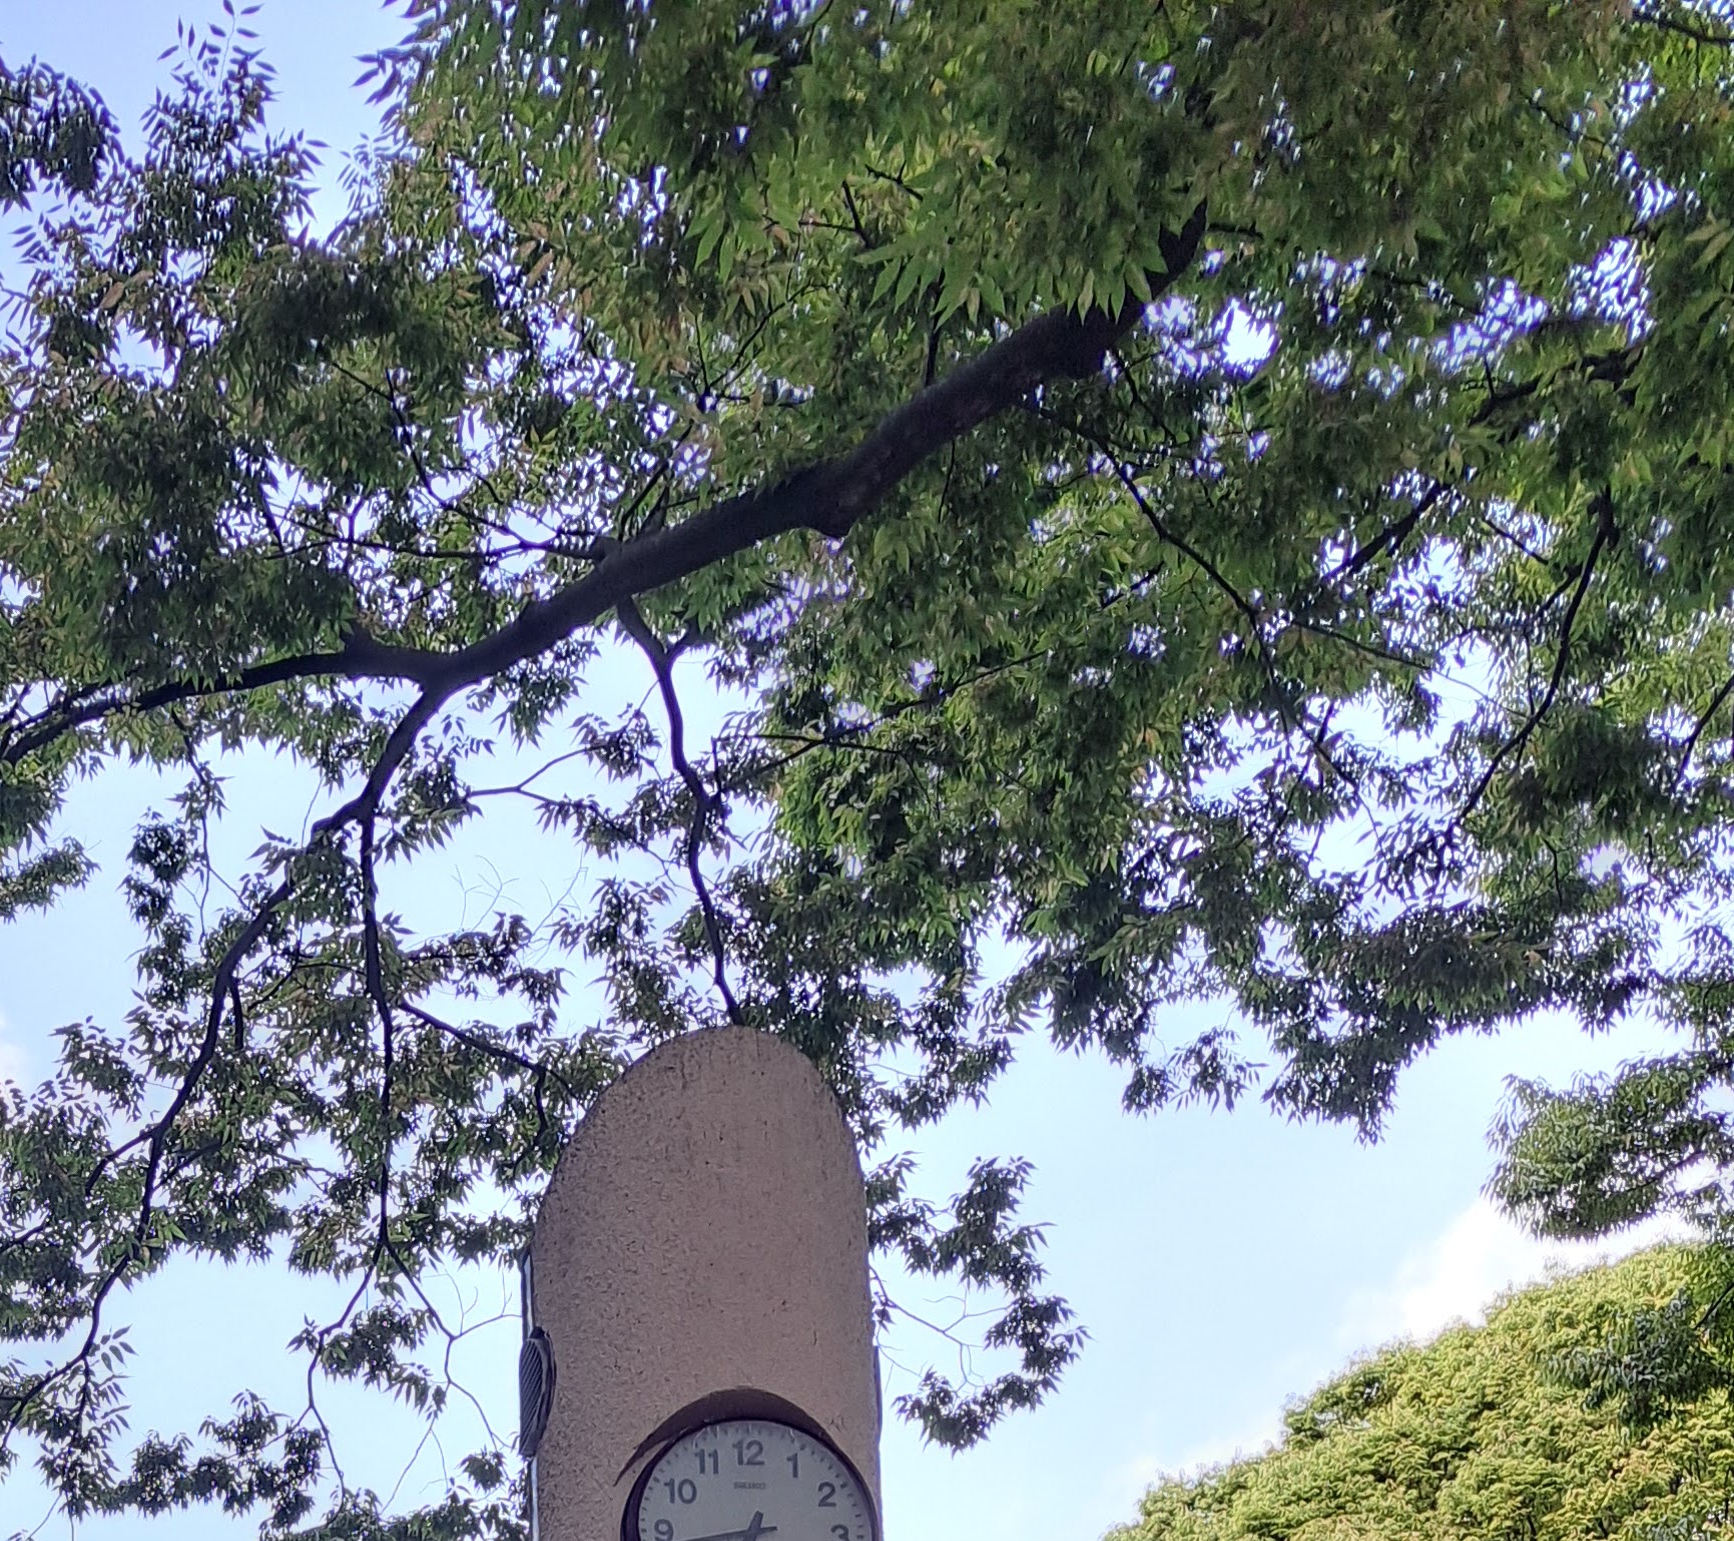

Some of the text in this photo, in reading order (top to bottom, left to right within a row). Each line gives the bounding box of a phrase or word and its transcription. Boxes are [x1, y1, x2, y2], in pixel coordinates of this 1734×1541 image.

[695, 1449, 720, 1475] 11
[733, 1440, 765, 1466] 12
[786, 1453, 800, 1478] 1
[665, 1478, 697, 1504] 10
[817, 1482, 837, 1507] 2
